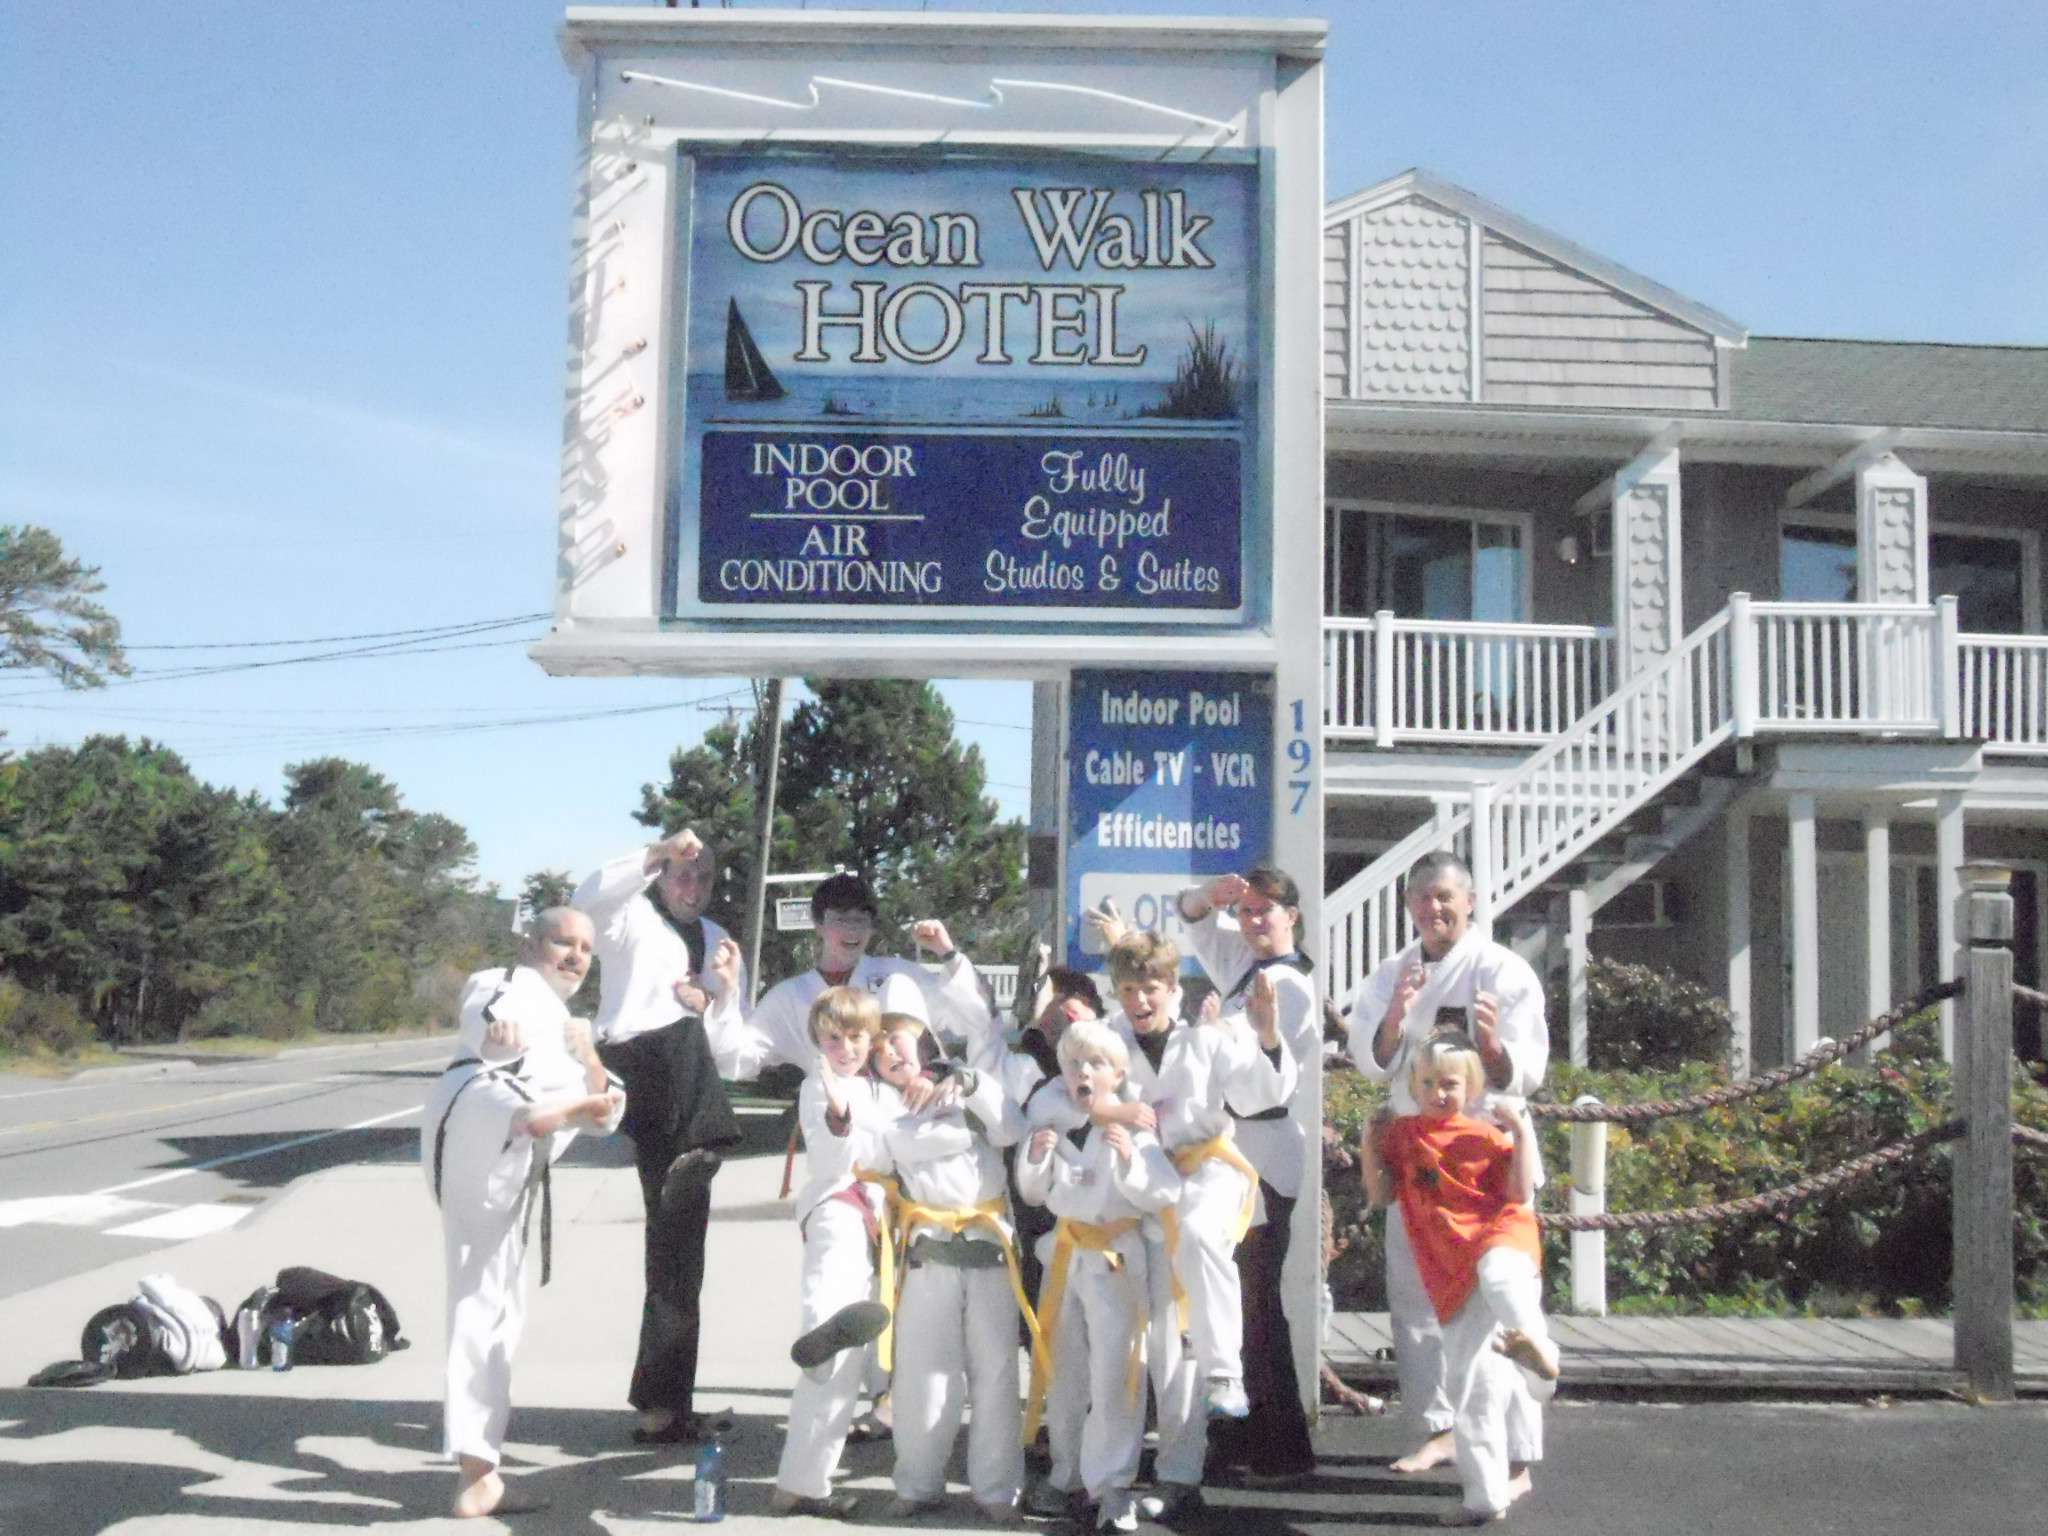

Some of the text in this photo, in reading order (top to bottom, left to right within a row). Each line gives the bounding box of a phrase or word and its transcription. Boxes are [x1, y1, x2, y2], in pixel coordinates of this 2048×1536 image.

[729, 182, 1214, 270] Ocean Walk
[794, 280, 1147, 367] HOTEL
[753, 443, 916, 477] INDOOR
[1041, 450, 1146, 504] Fully
[784, 479, 889, 511] POOL
[799, 525, 869, 556] AIR
[1020, 495, 1171, 547] Equipped
[719, 559, 943, 594] CONDITIONING
[983, 550, 1220, 594] Studios & Suites
[1102, 689, 1240, 726] Indoor Pool
[1085, 749, 1144, 785] Cable
[1153, 751, 1186, 786] TV
[1210, 752, 1256, 787] VCR
[1287, 698, 1312, 816] 197
[1097, 811, 1241, 850] Efficiencies
